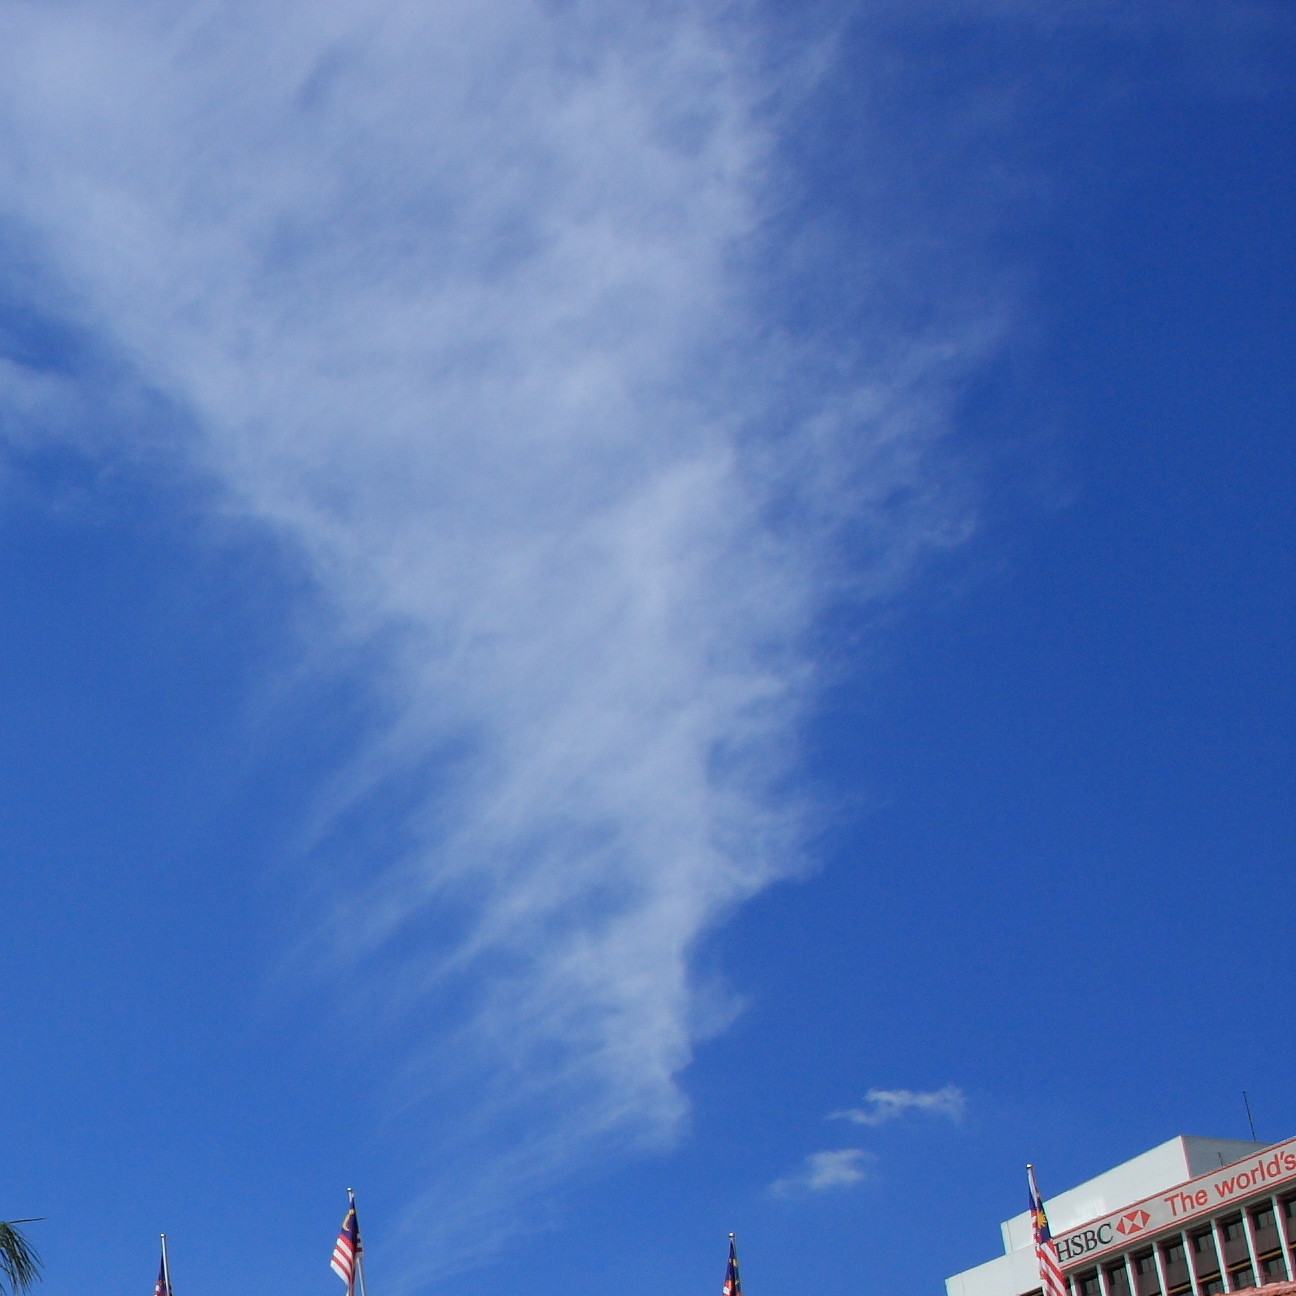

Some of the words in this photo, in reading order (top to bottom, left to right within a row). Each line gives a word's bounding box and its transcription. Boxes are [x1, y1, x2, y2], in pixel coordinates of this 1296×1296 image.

[1054, 1222, 1114, 1264] HSBC
[1164, 1187, 1208, 1217] The
[1214, 1151, 1296, 1198] world's
